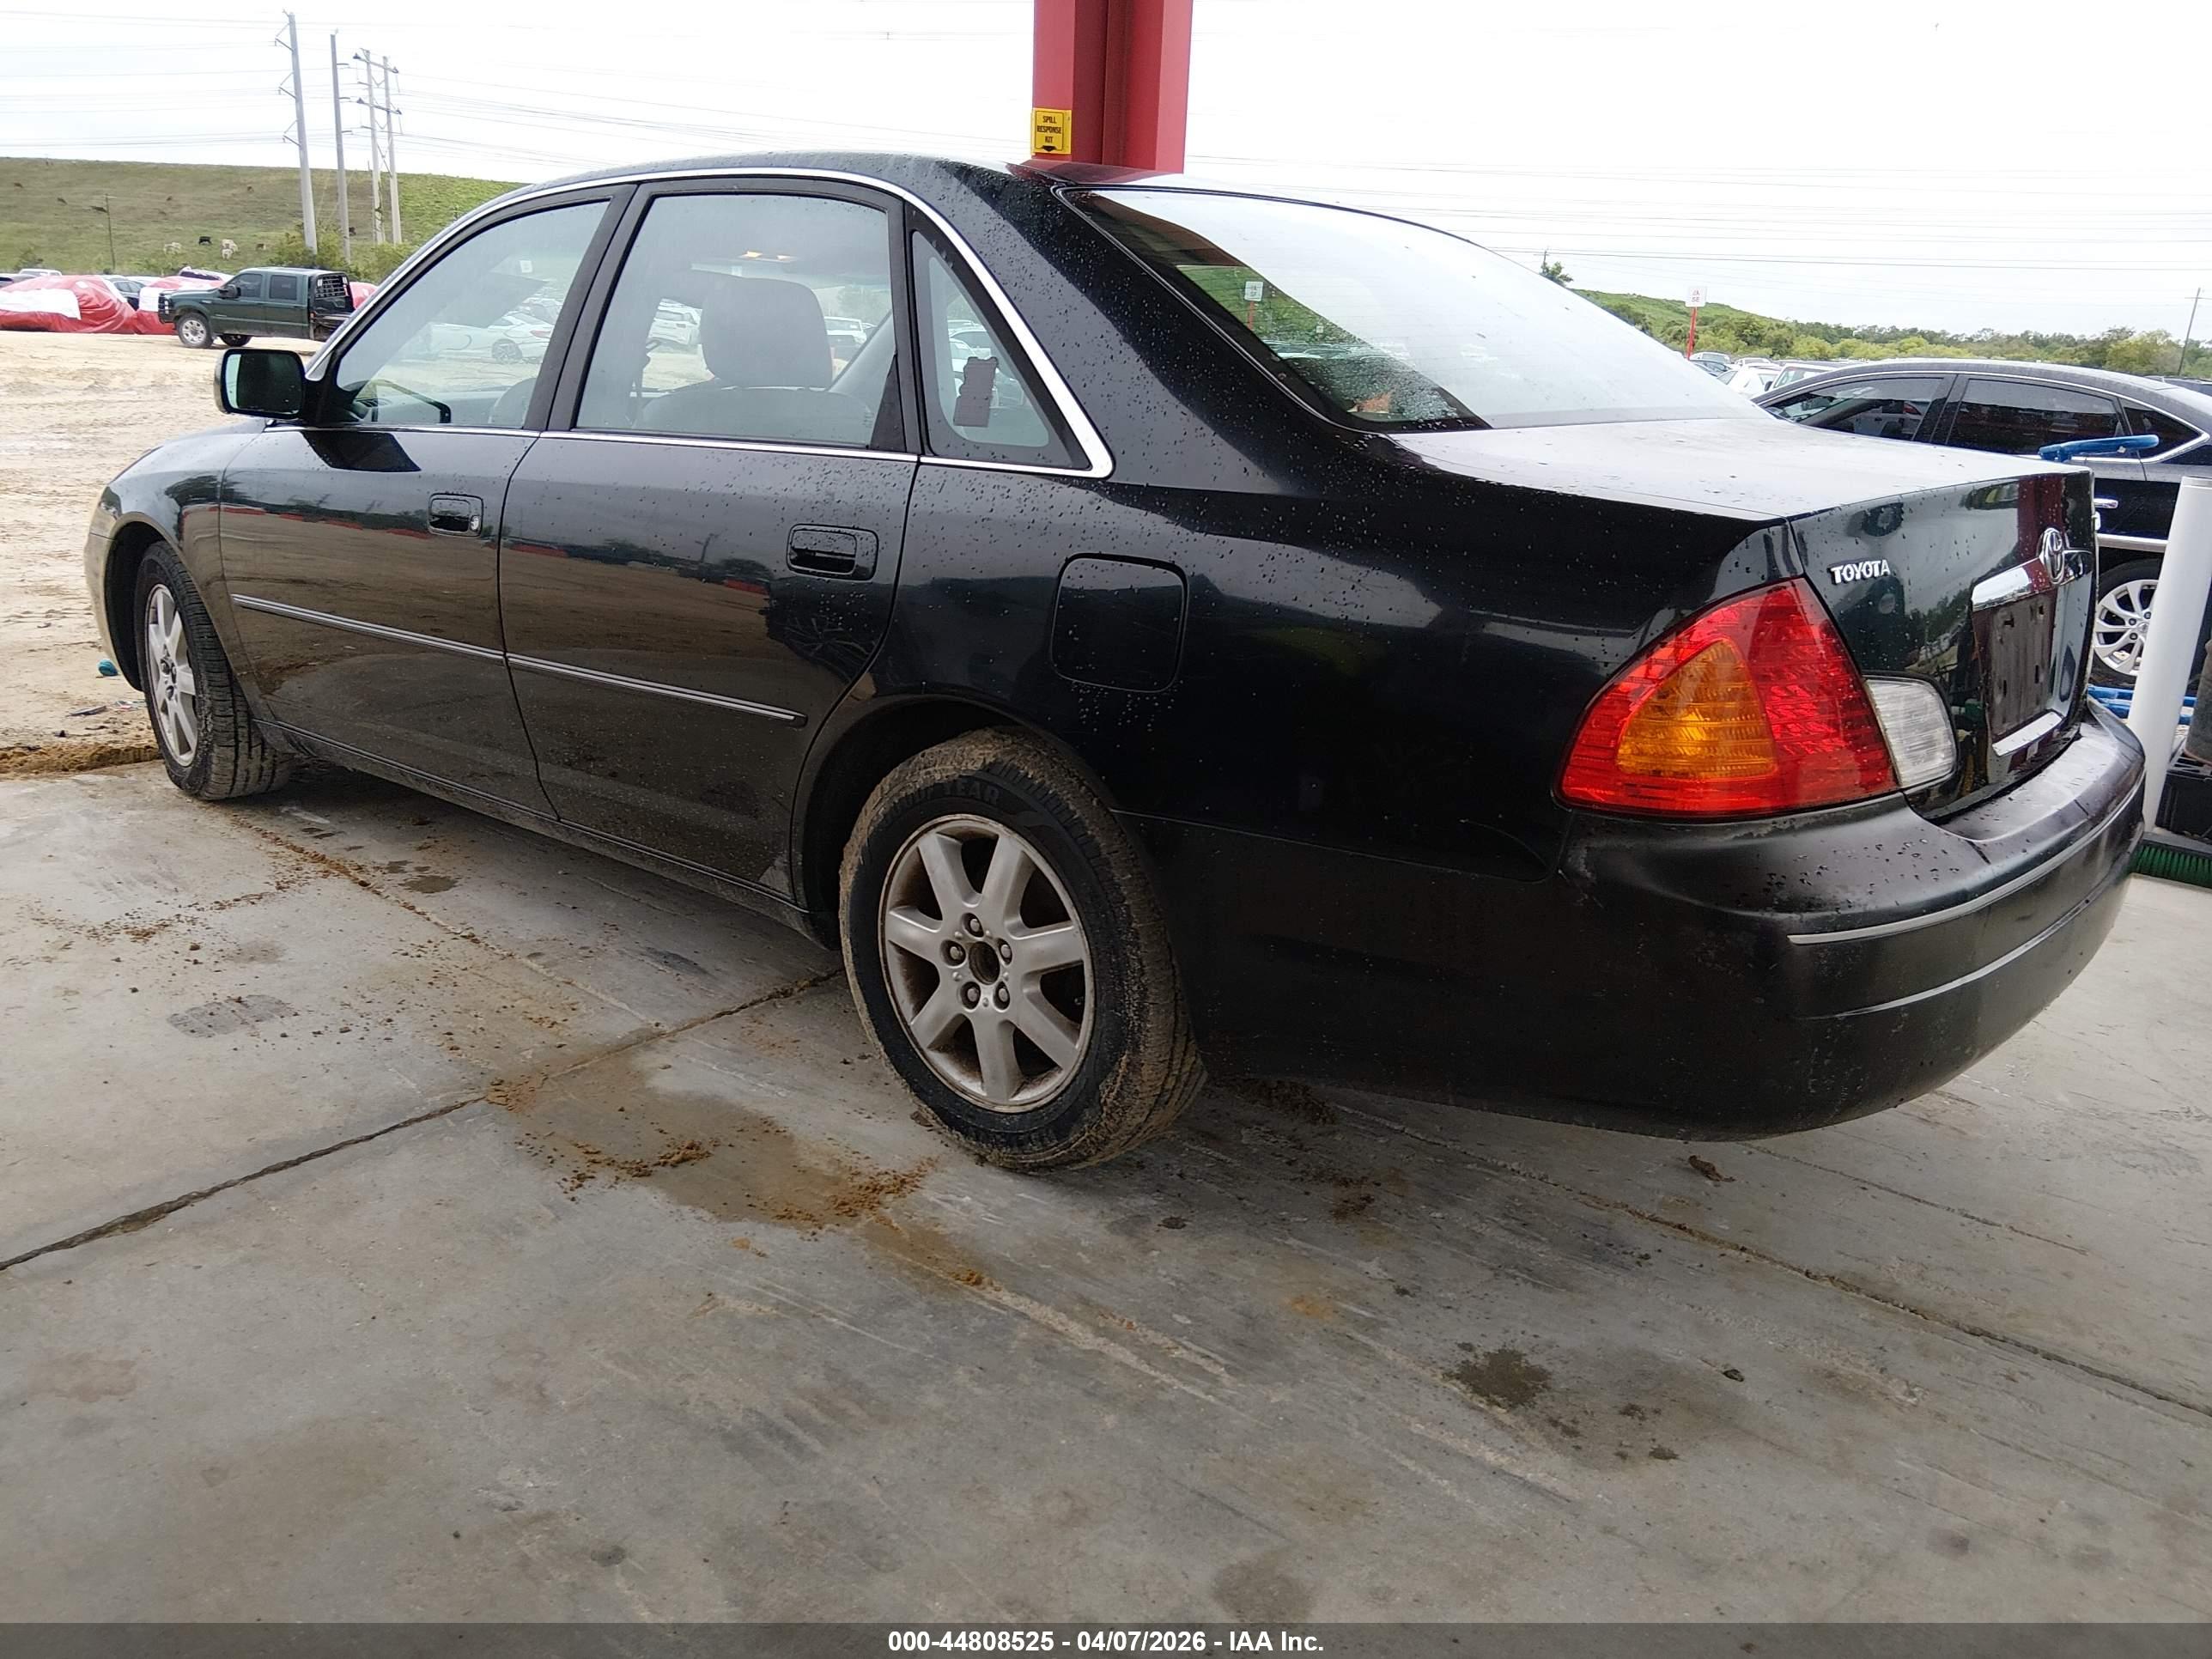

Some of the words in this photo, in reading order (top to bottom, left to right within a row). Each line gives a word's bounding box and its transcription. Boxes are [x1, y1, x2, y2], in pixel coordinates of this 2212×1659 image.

[1042, 115, 1057, 124] SPILL
[1036, 125, 1062, 134] RESPONSE
[1830, 559, 1891, 584] TOYOTA
